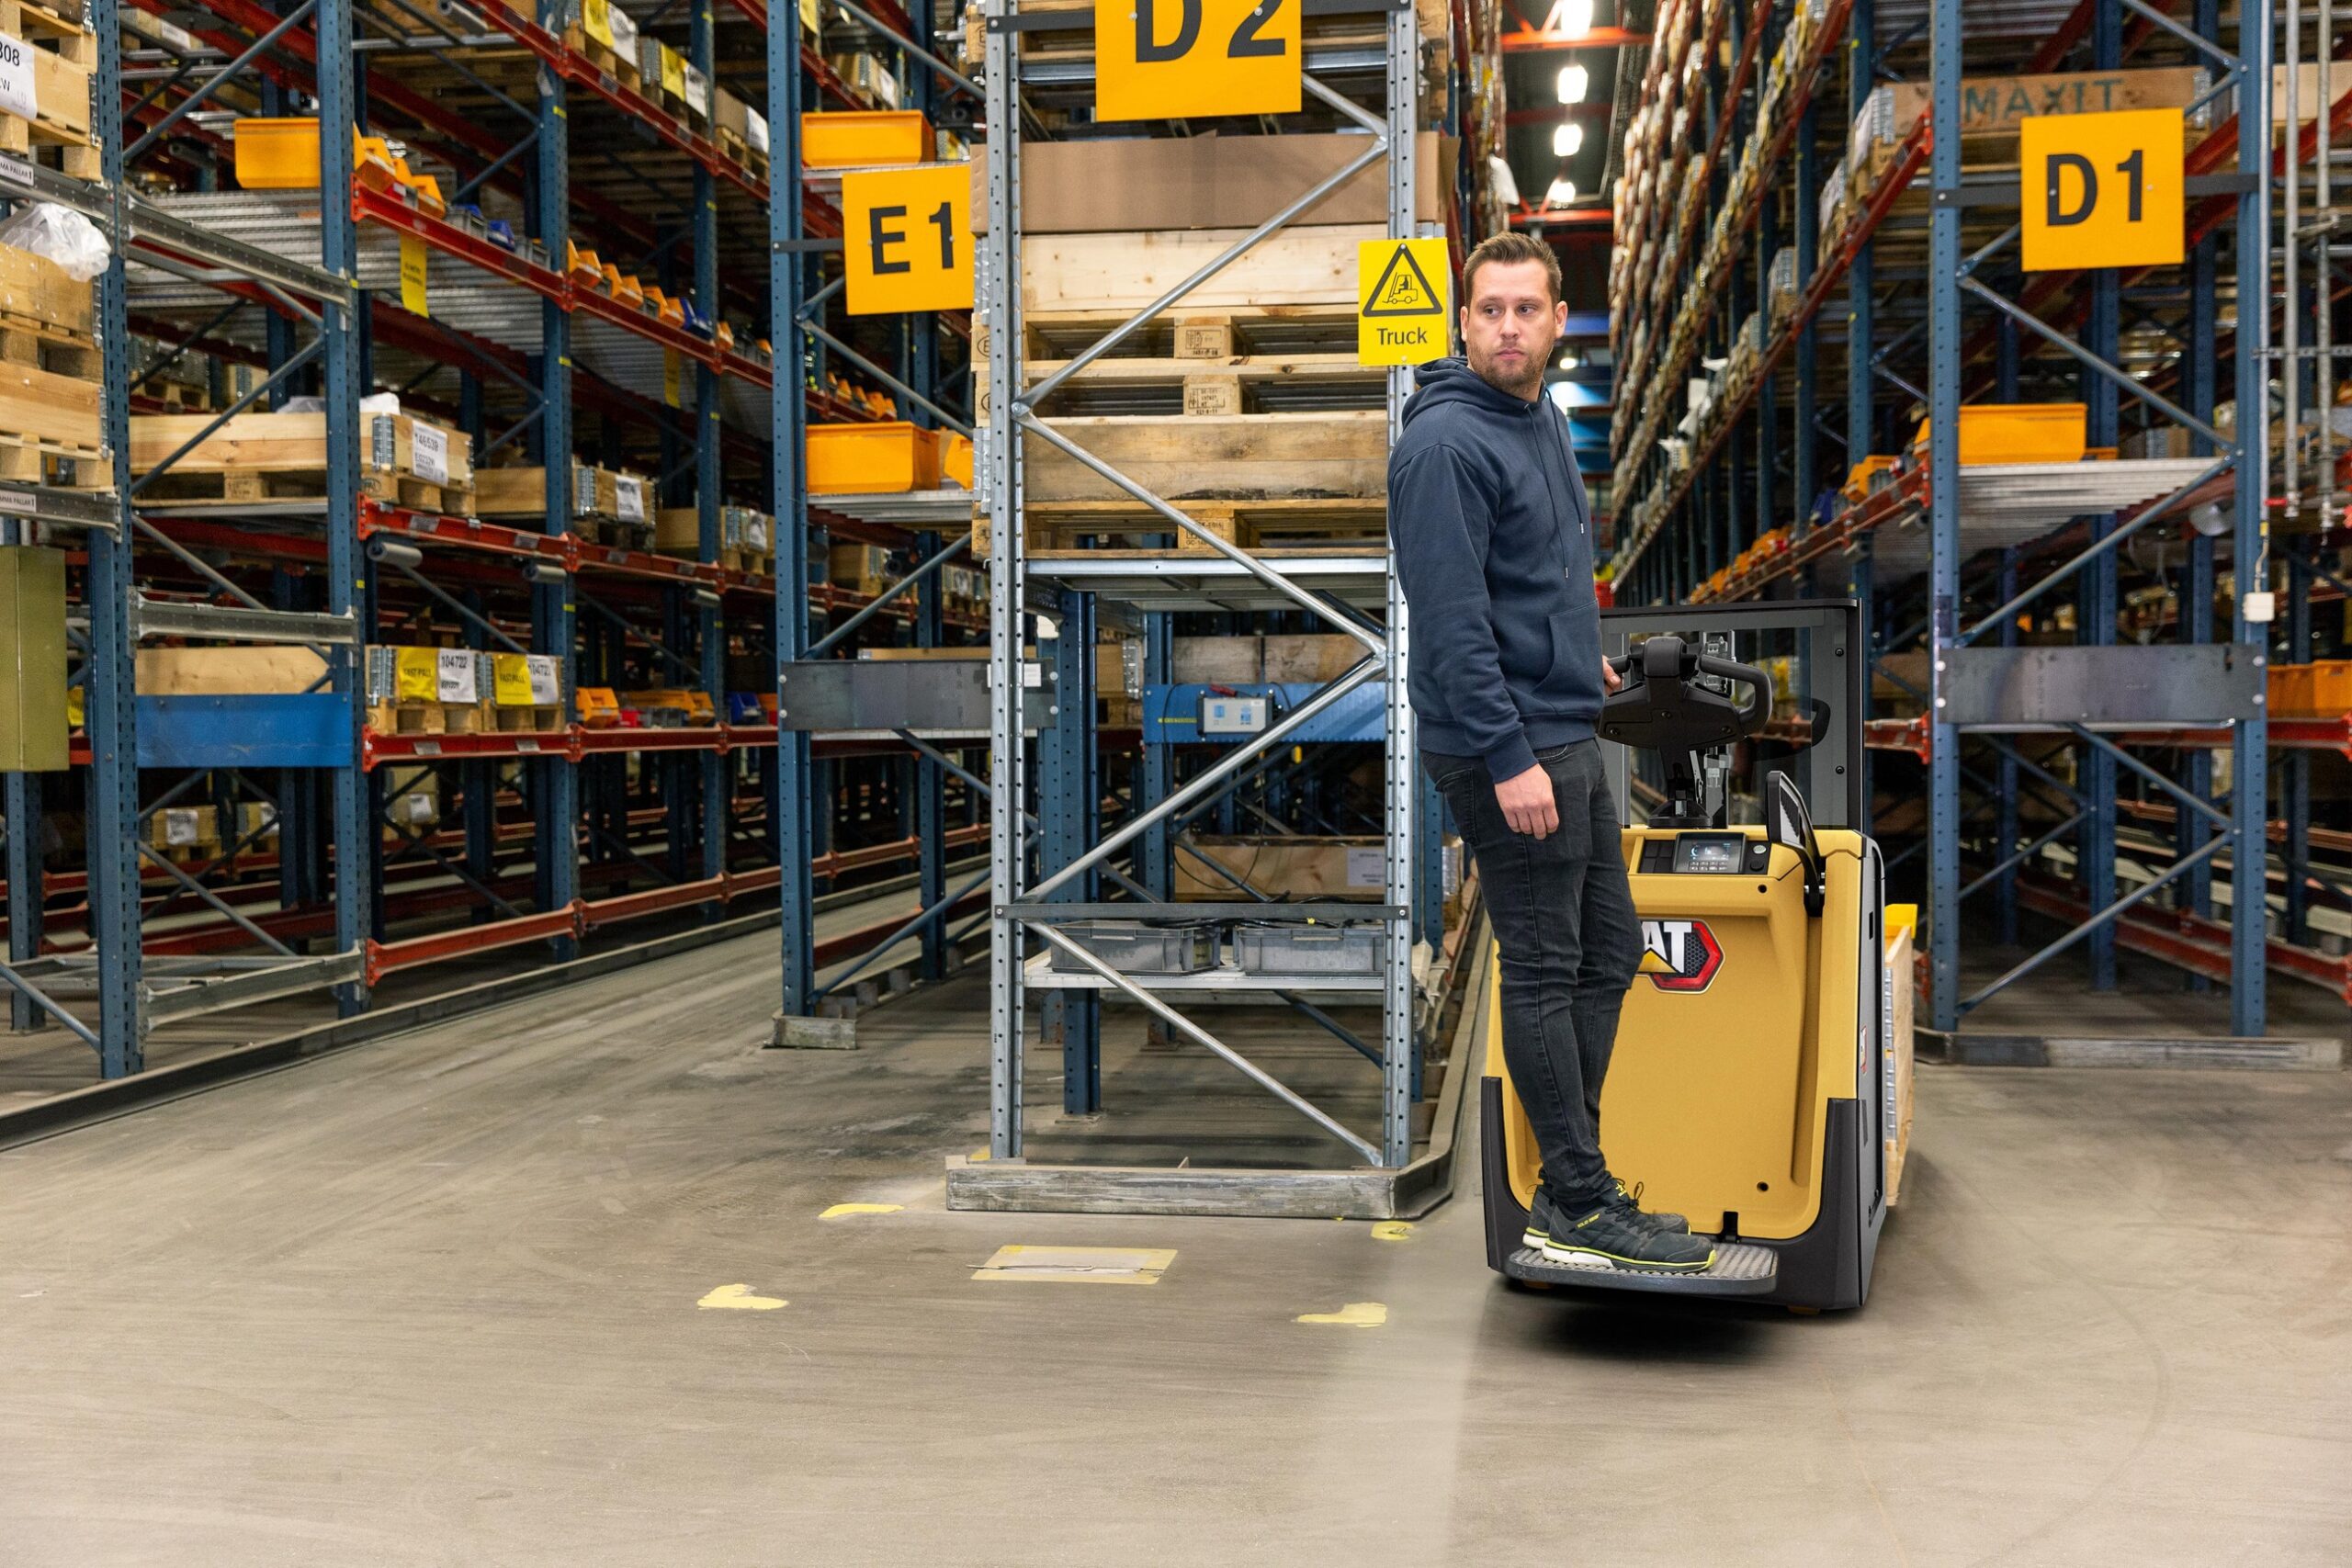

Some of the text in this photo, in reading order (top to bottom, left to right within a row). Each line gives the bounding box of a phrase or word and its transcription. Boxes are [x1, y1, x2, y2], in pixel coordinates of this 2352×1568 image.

[1965, 79, 2122, 123] MAXIT
[1376, 326, 1428, 345] Truck
[1641, 921, 1692, 974] AT
